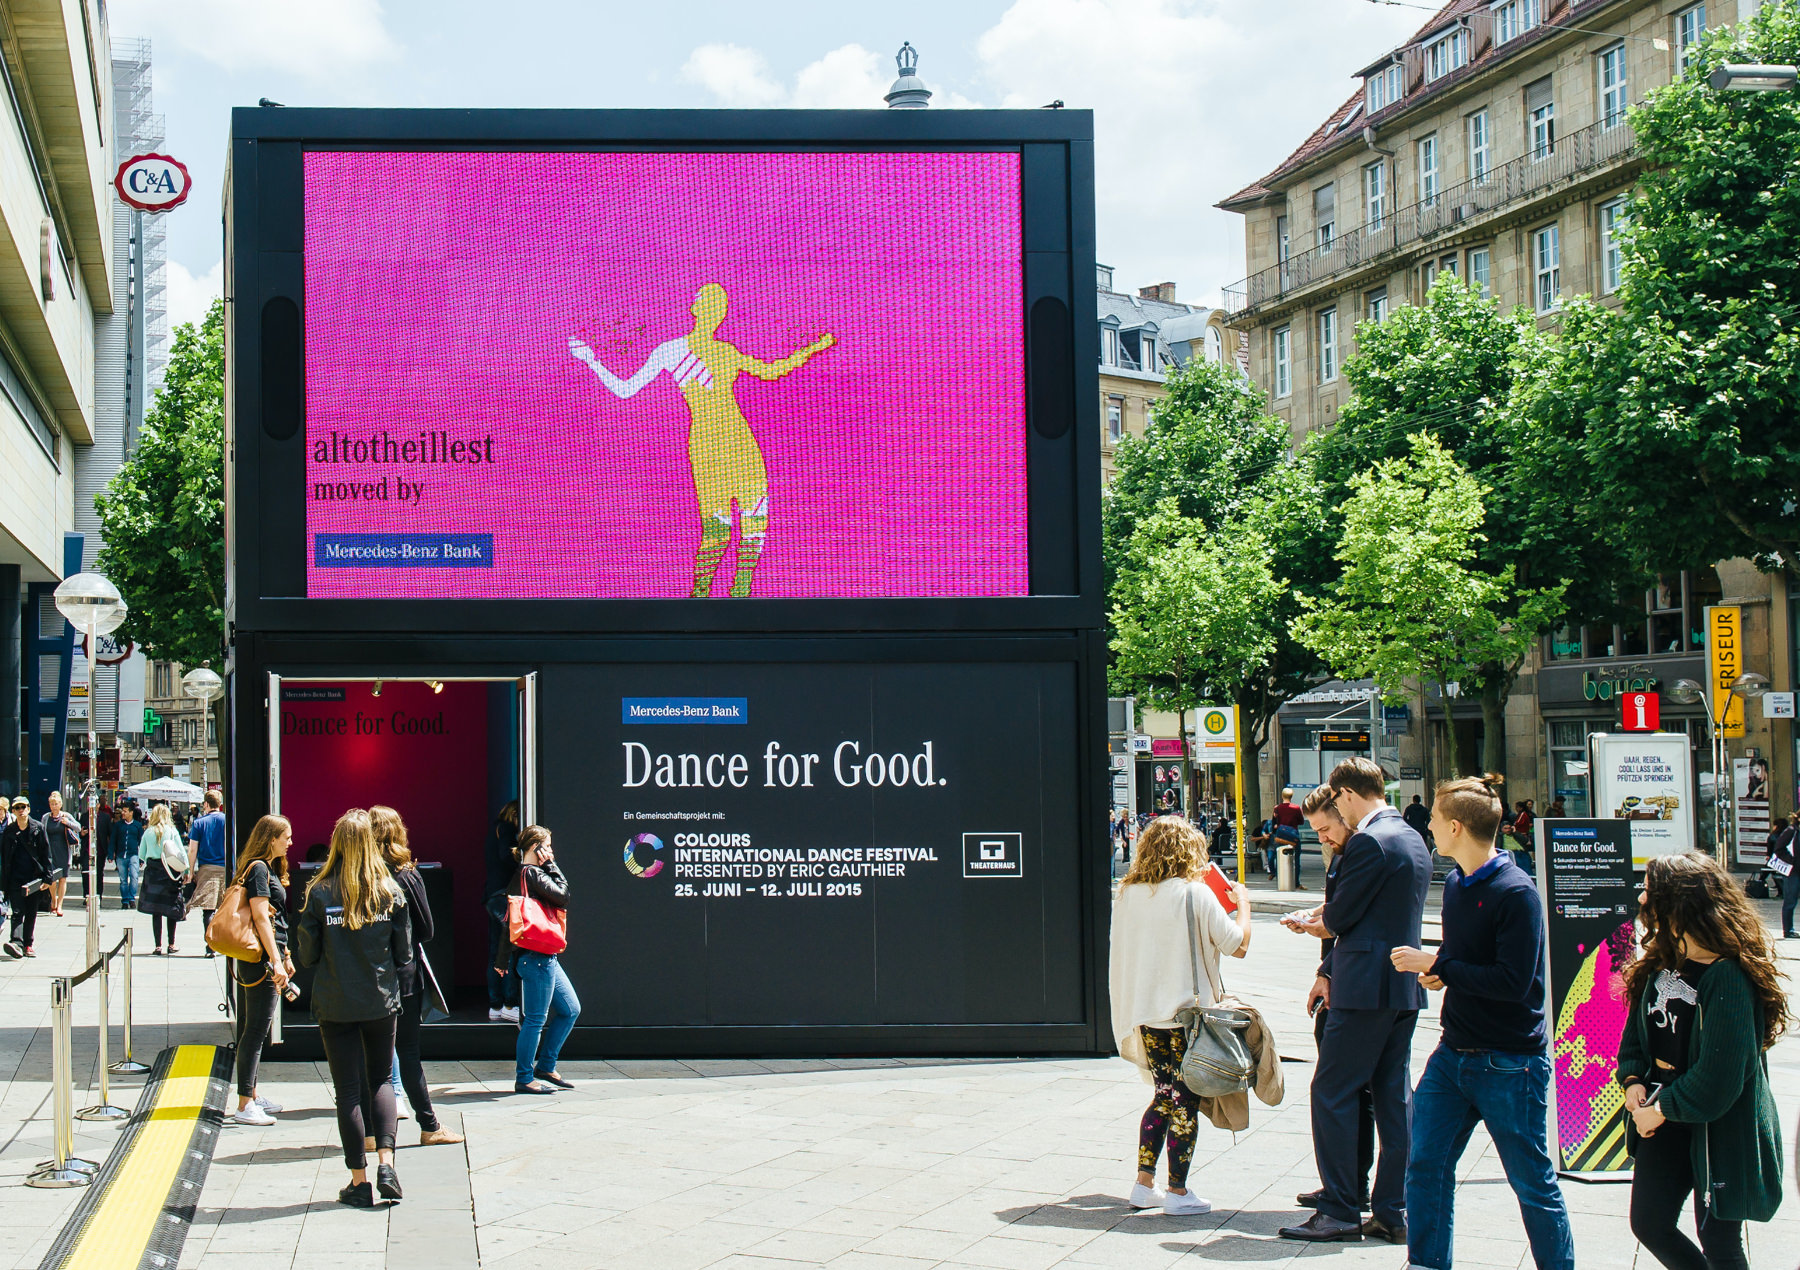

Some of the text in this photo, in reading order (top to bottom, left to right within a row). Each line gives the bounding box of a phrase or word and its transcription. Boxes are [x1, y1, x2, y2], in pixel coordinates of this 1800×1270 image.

[129, 168, 177, 194] C&A
[314, 431, 495, 464] altotheillest
[314, 477, 424, 505] moved by
[326, 543, 482, 558] Mercedes-Benz Bank
[1717, 613, 1735, 689] FRISEUR
[630, 705, 739, 717] Mercedes-Benz Bank
[282, 712, 450, 735] Dance for Good.
[622, 741, 947, 787] Dance for Good.
[1618, 765, 1671, 773] COOL! LASS UNS IN
[1617, 773, 1674, 782] PFÜTZEN SPRINGEN!
[624, 812, 726, 821] Ein Gemeinschaftsprojekt mit:
[674, 833, 751, 848] COLOURS
[1553, 842, 1617, 853] Dance for Good.
[674, 847, 938, 862] INTERNATIONAL DANCE FESTIVAL
[675, 863, 906, 878] PRESENTED BY ERIC GAUTHIER
[970, 861, 1016, 869] THEATERHAUS
[675, 884, 698, 897] 25.
[702, 883, 741, 897] JUNI
[760, 884, 782, 897] 12.
[787, 883, 822, 896] JULI
[826, 883, 862, 896] 2015
